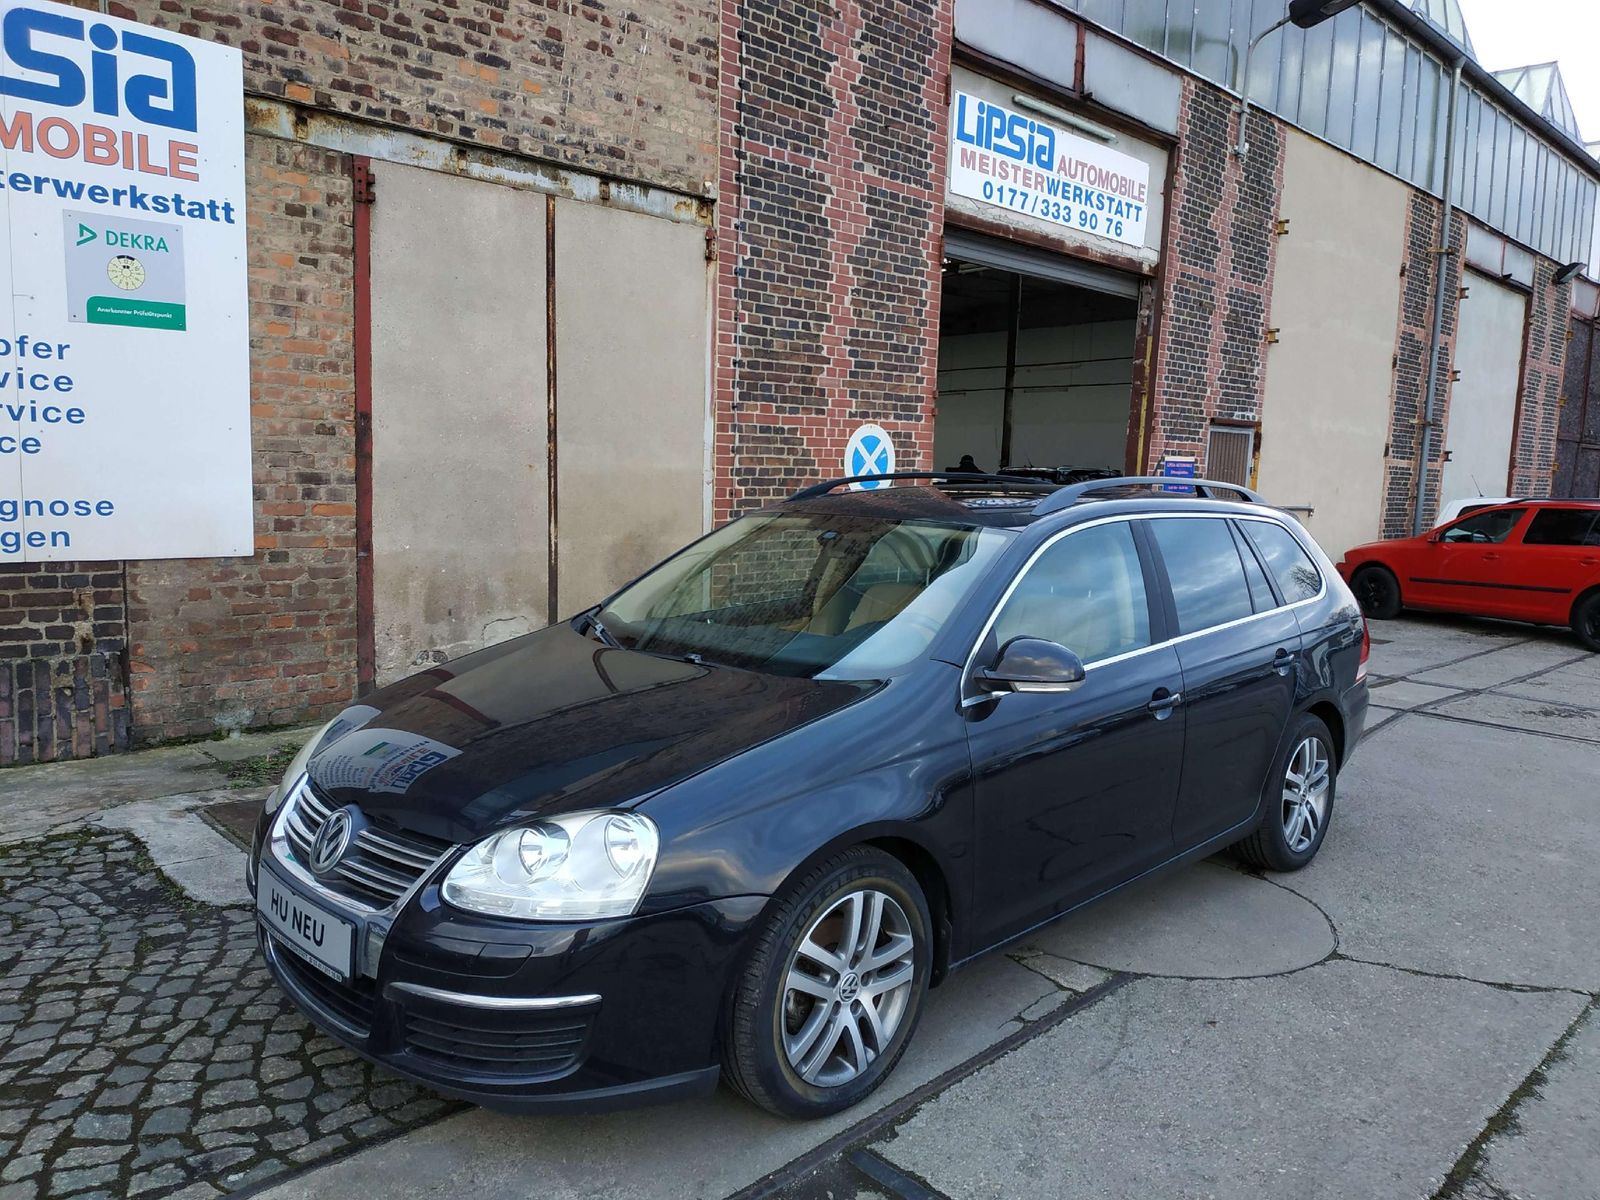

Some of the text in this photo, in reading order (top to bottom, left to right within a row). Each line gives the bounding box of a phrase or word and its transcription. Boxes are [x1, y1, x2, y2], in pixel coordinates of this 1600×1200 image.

[0, 110, 200, 182] MOBILE
[960, 147, 1143, 223] MEISTERWERKSTATT
[1056, 154, 1146, 203] AUTOMOBILE
[983, 181, 1123, 238] 0177/333 90 76
[105, 230, 169, 253] DEKRA
[0, 400, 86, 424] vice
[0, 500, 115, 522] gnose
[0, 530, 71, 554] gen
[271, 888, 325, 947] HU NEU
